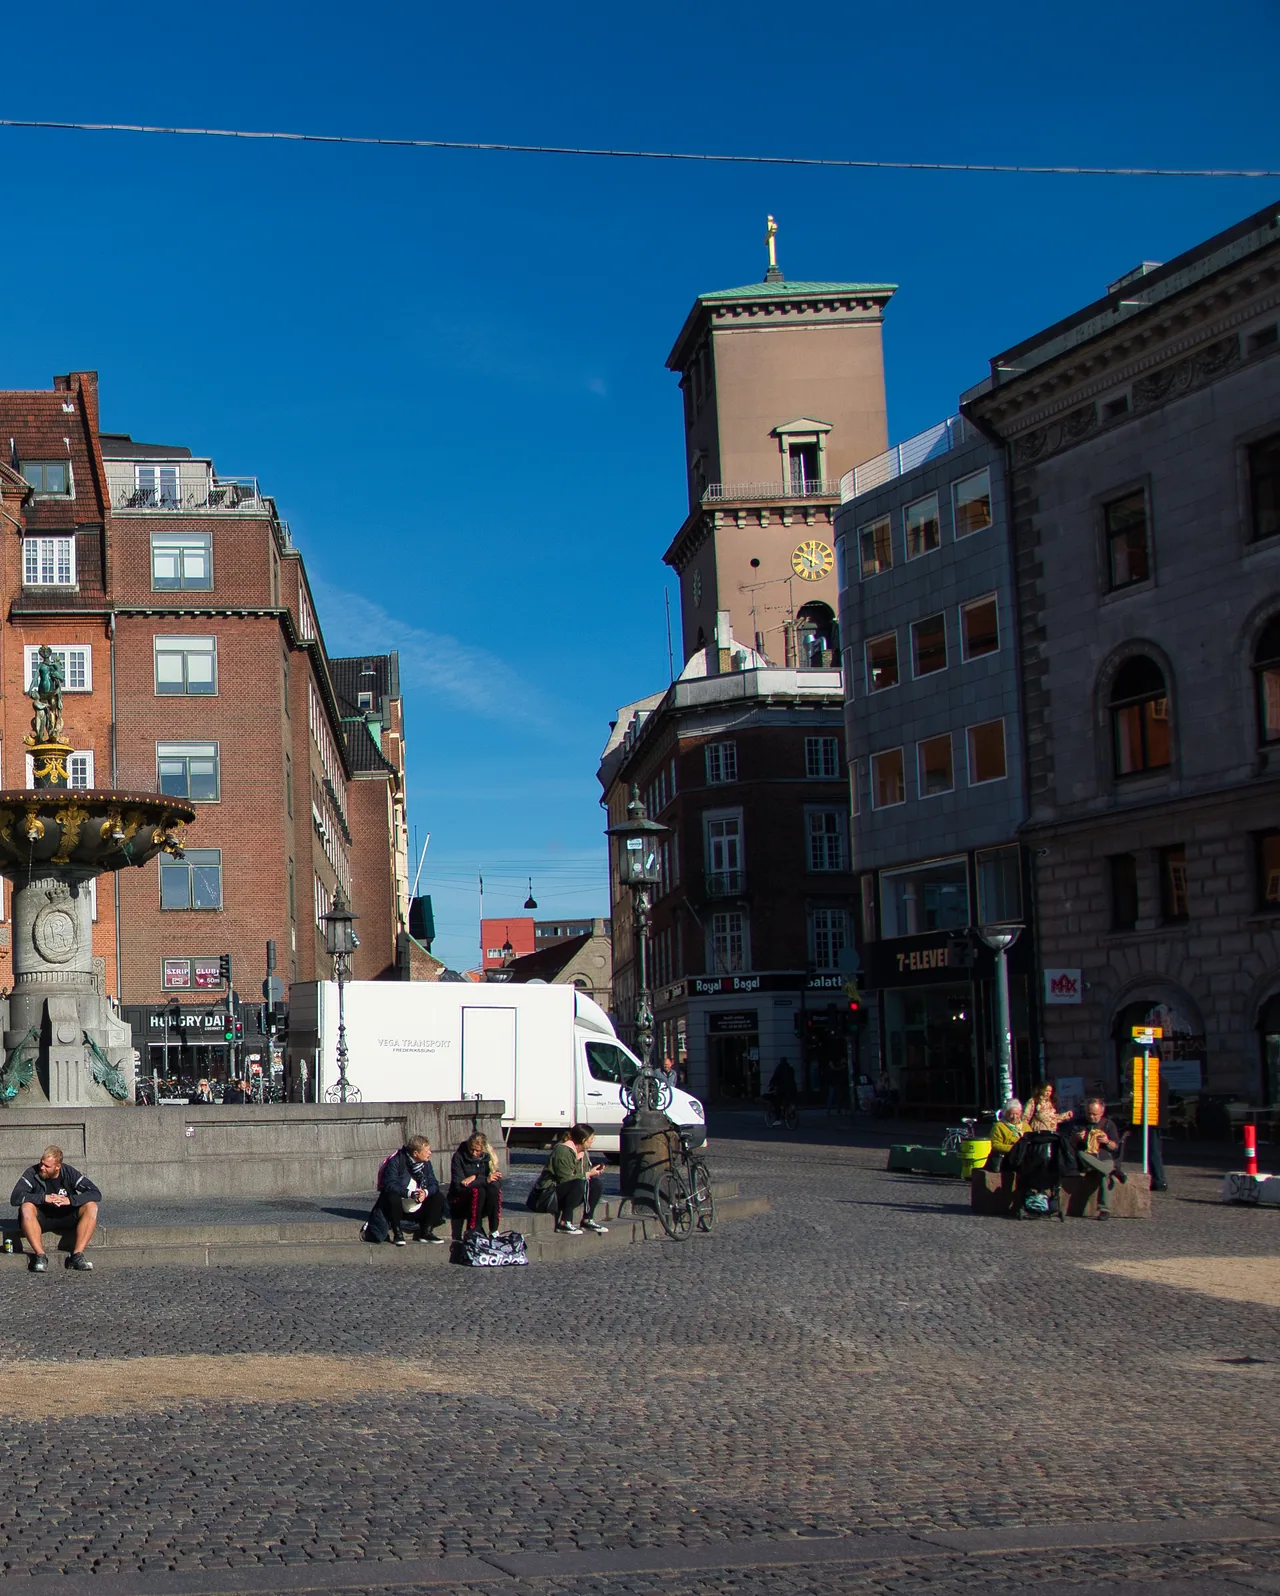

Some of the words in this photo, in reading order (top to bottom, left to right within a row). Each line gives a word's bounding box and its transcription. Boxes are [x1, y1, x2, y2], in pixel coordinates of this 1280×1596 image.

[696, 978, 722, 994] Royal
[733, 976, 760, 992] Bagel
[1051, 973, 1078, 993] MAX
[377, 1039, 400, 1047] VEGA
[402, 1039, 451, 1048] TRANSPORT
[479, 1253, 525, 1266] adidas
